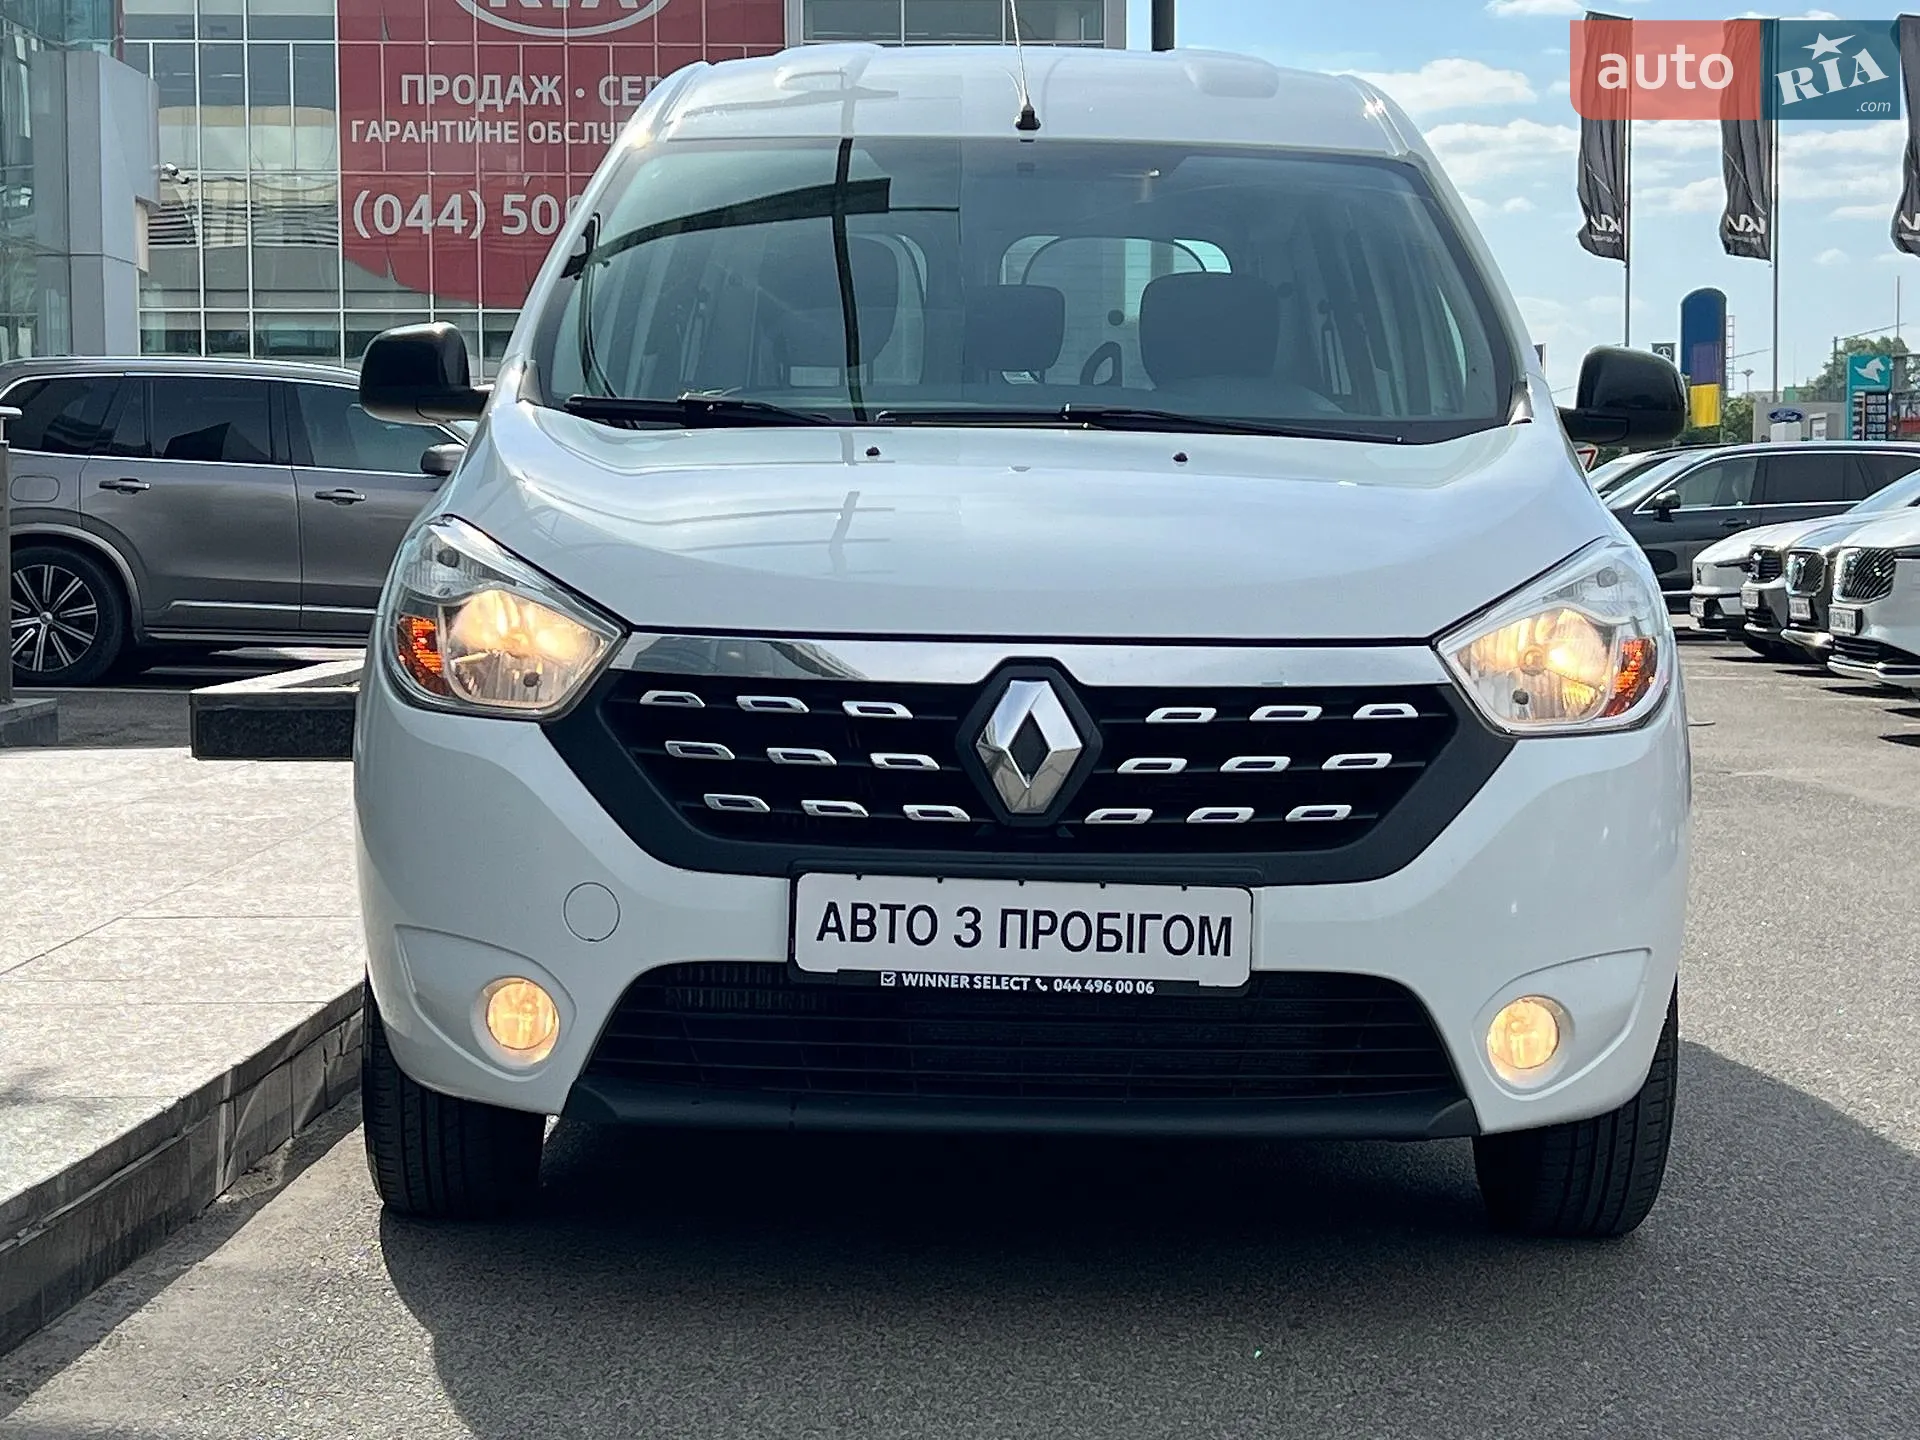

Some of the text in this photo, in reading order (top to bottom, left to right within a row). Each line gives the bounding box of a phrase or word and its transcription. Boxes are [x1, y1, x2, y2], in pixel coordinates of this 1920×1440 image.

[400, 74, 562, 112] ПРОДАЖ
[351, 116, 519, 144] ГАРАНТІЙНЕ
[353, 190, 487, 239] (044)
[816, 901, 938, 946] АВТО
[999, 908, 1233, 957] ПРОБІГОМ
[901, 972, 1155, 995] WINNER SELECT 044 496 00 06
